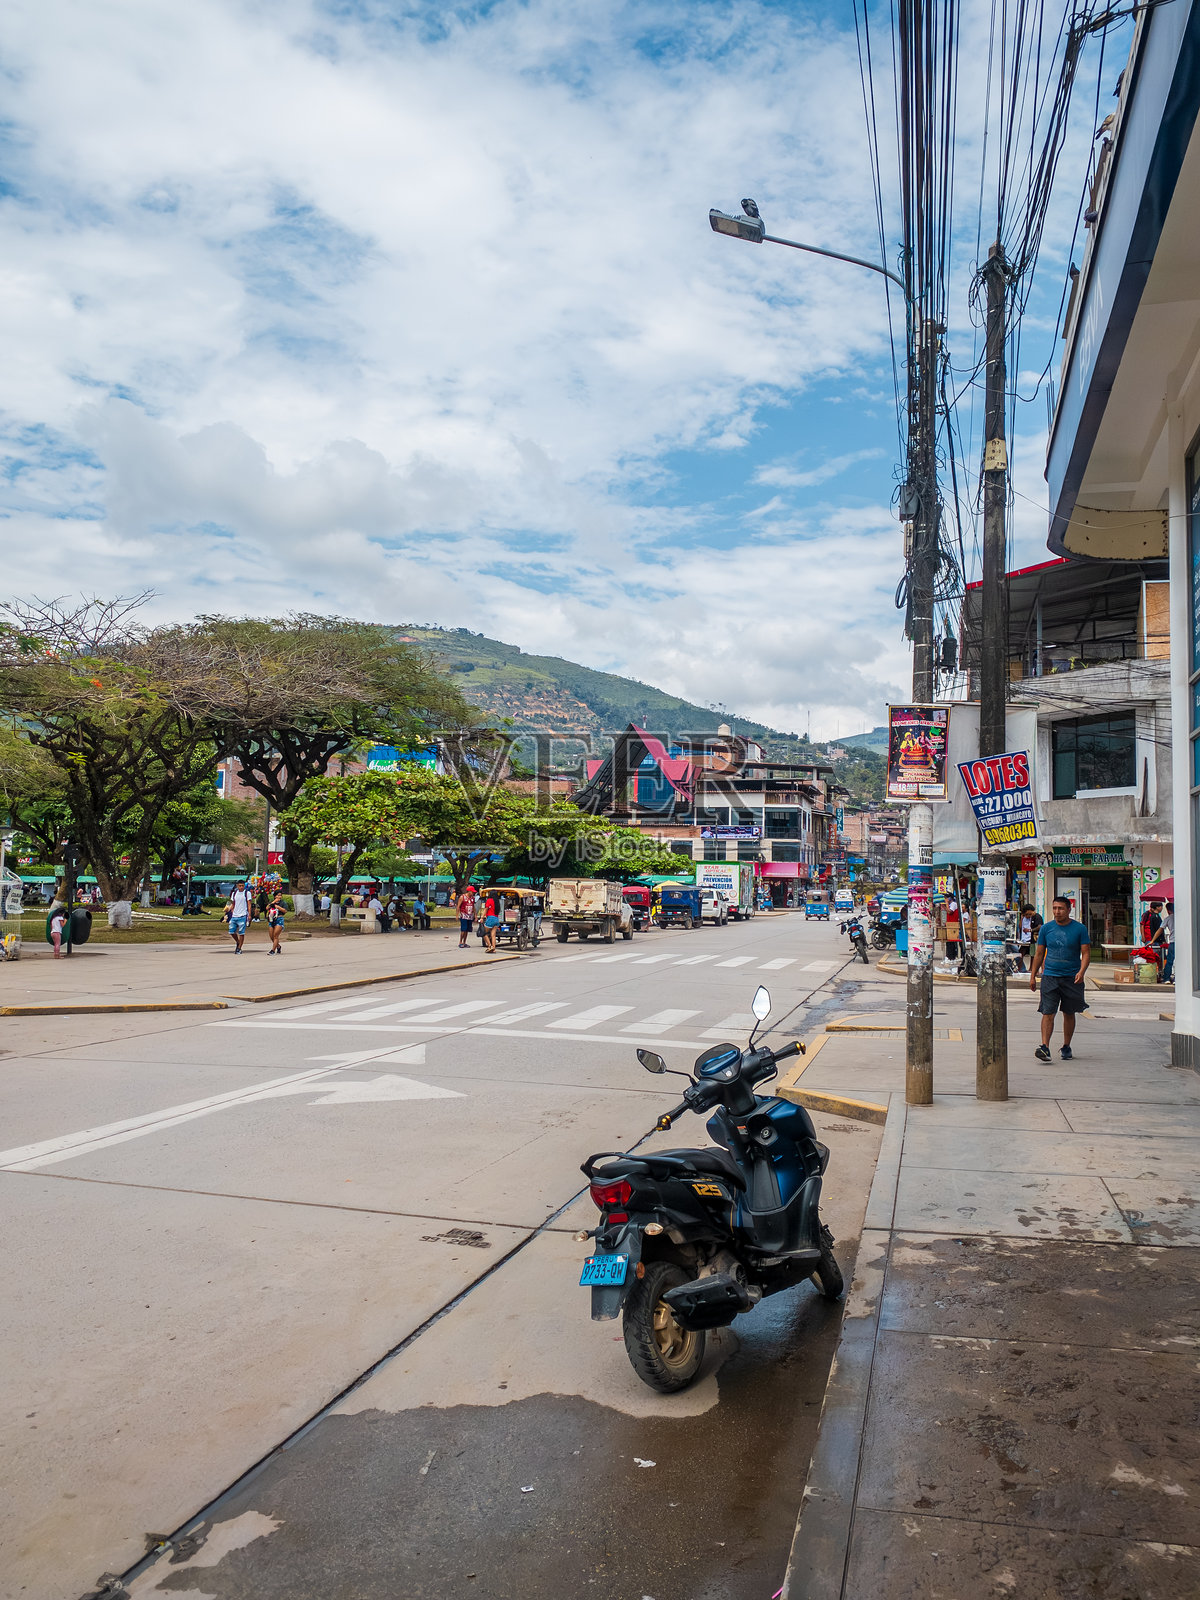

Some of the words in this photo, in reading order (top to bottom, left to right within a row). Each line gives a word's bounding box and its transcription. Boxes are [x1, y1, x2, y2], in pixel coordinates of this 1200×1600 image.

[959, 753, 1029, 798] LOTES
[1070, 846, 1107, 854] BOTICA
[1053, 853, 1081, 863] HERAL
[1092, 852, 1125, 863] FARMA
[692, 1183, 722, 1197] 125
[596, 1255, 613, 1264] PERU
[583, 1263, 624, 1280] 9733-QW
